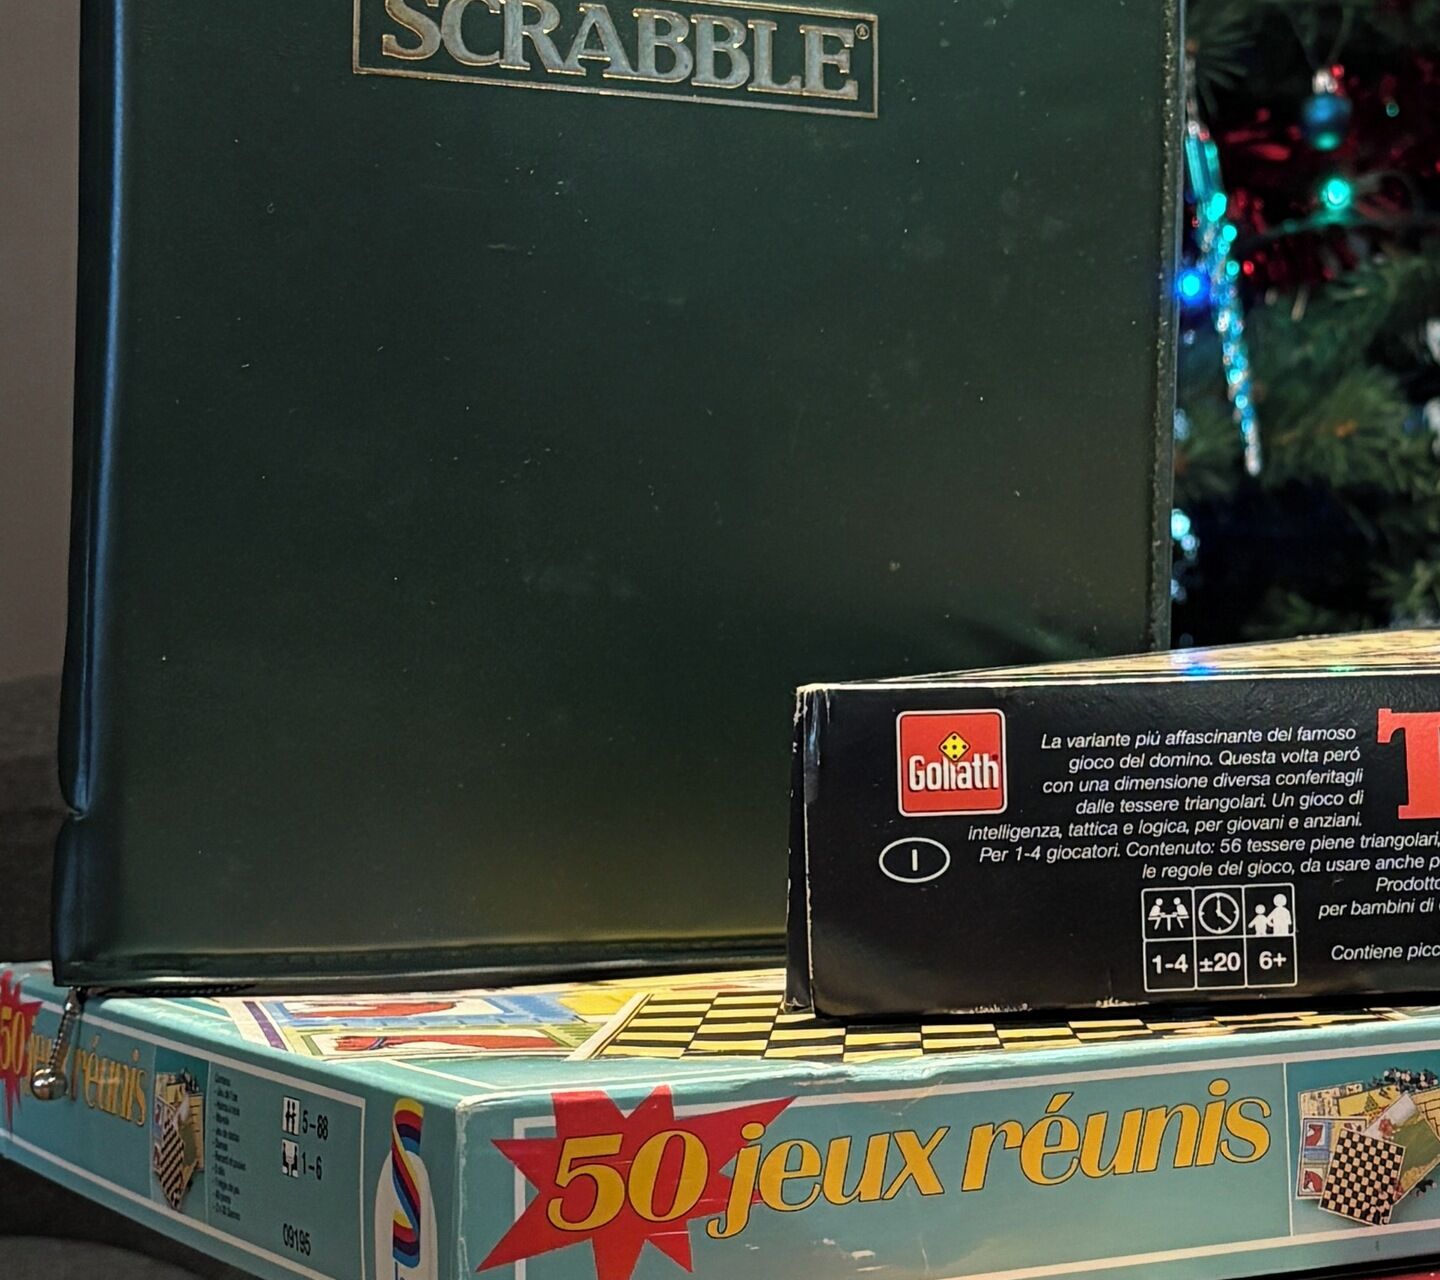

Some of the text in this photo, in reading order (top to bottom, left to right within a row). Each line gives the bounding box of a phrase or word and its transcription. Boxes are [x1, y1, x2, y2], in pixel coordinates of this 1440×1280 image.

[1041, 733, 1062, 749] La
[1066, 732, 1131, 748] variante
[1165, 729, 1263, 746] affascinante
[1267, 727, 1293, 742] del
[1297, 726, 1357, 741] famoso
[1068, 755, 1115, 774] gioco
[1119, 753, 1145, 769] del
[1149, 752, 1213, 768] domino.
[1218, 750, 1276, 766] Questa
[1281, 748, 1319, 763] volta
[908, 756, 1000, 793] Goliath
[1042, 768, 1364, 793] con una dimensione diversa conferitagli
[1075, 789, 1364, 815] dalle tessere triangolari. Un gioco di
[968, 811, 1362, 843] intelligenza, tattica e logica, per giovani e anziani.
[979, 846, 1009, 863] Per
[1015, 845, 1041, 861] 1-4
[1046, 842, 1121, 864] giocatori.
[1126, 840, 1215, 857] Contenuto:
[1219, 838, 1242, 853] 56
[1247, 838, 1306, 853] tessere
[1309, 835, 1355, 854] piene
[1360, 831, 1440, 851] triangolari,
[1142, 863, 1157, 879] le
[1161, 861, 1213, 881] regole
[1217, 860, 1244, 876] del
[1247, 859, 1295, 878] gioco,
[1300, 857, 1321, 873] da
[1326, 858, 1371, 872] usare
[1375, 854, 1425, 870] anche
[1318, 904, 1348, 920] per
[1350, 898, 1416, 916] bambini
[1419, 897, 1435, 913] di
[1151, 953, 1288, 974] 1-4 ±20 6+
[1331, 944, 1403, 961] Contiene
[548, 1080, 1271, 1239] 50 jeux réunis
[283, 1223, 312, 1257] 09195
